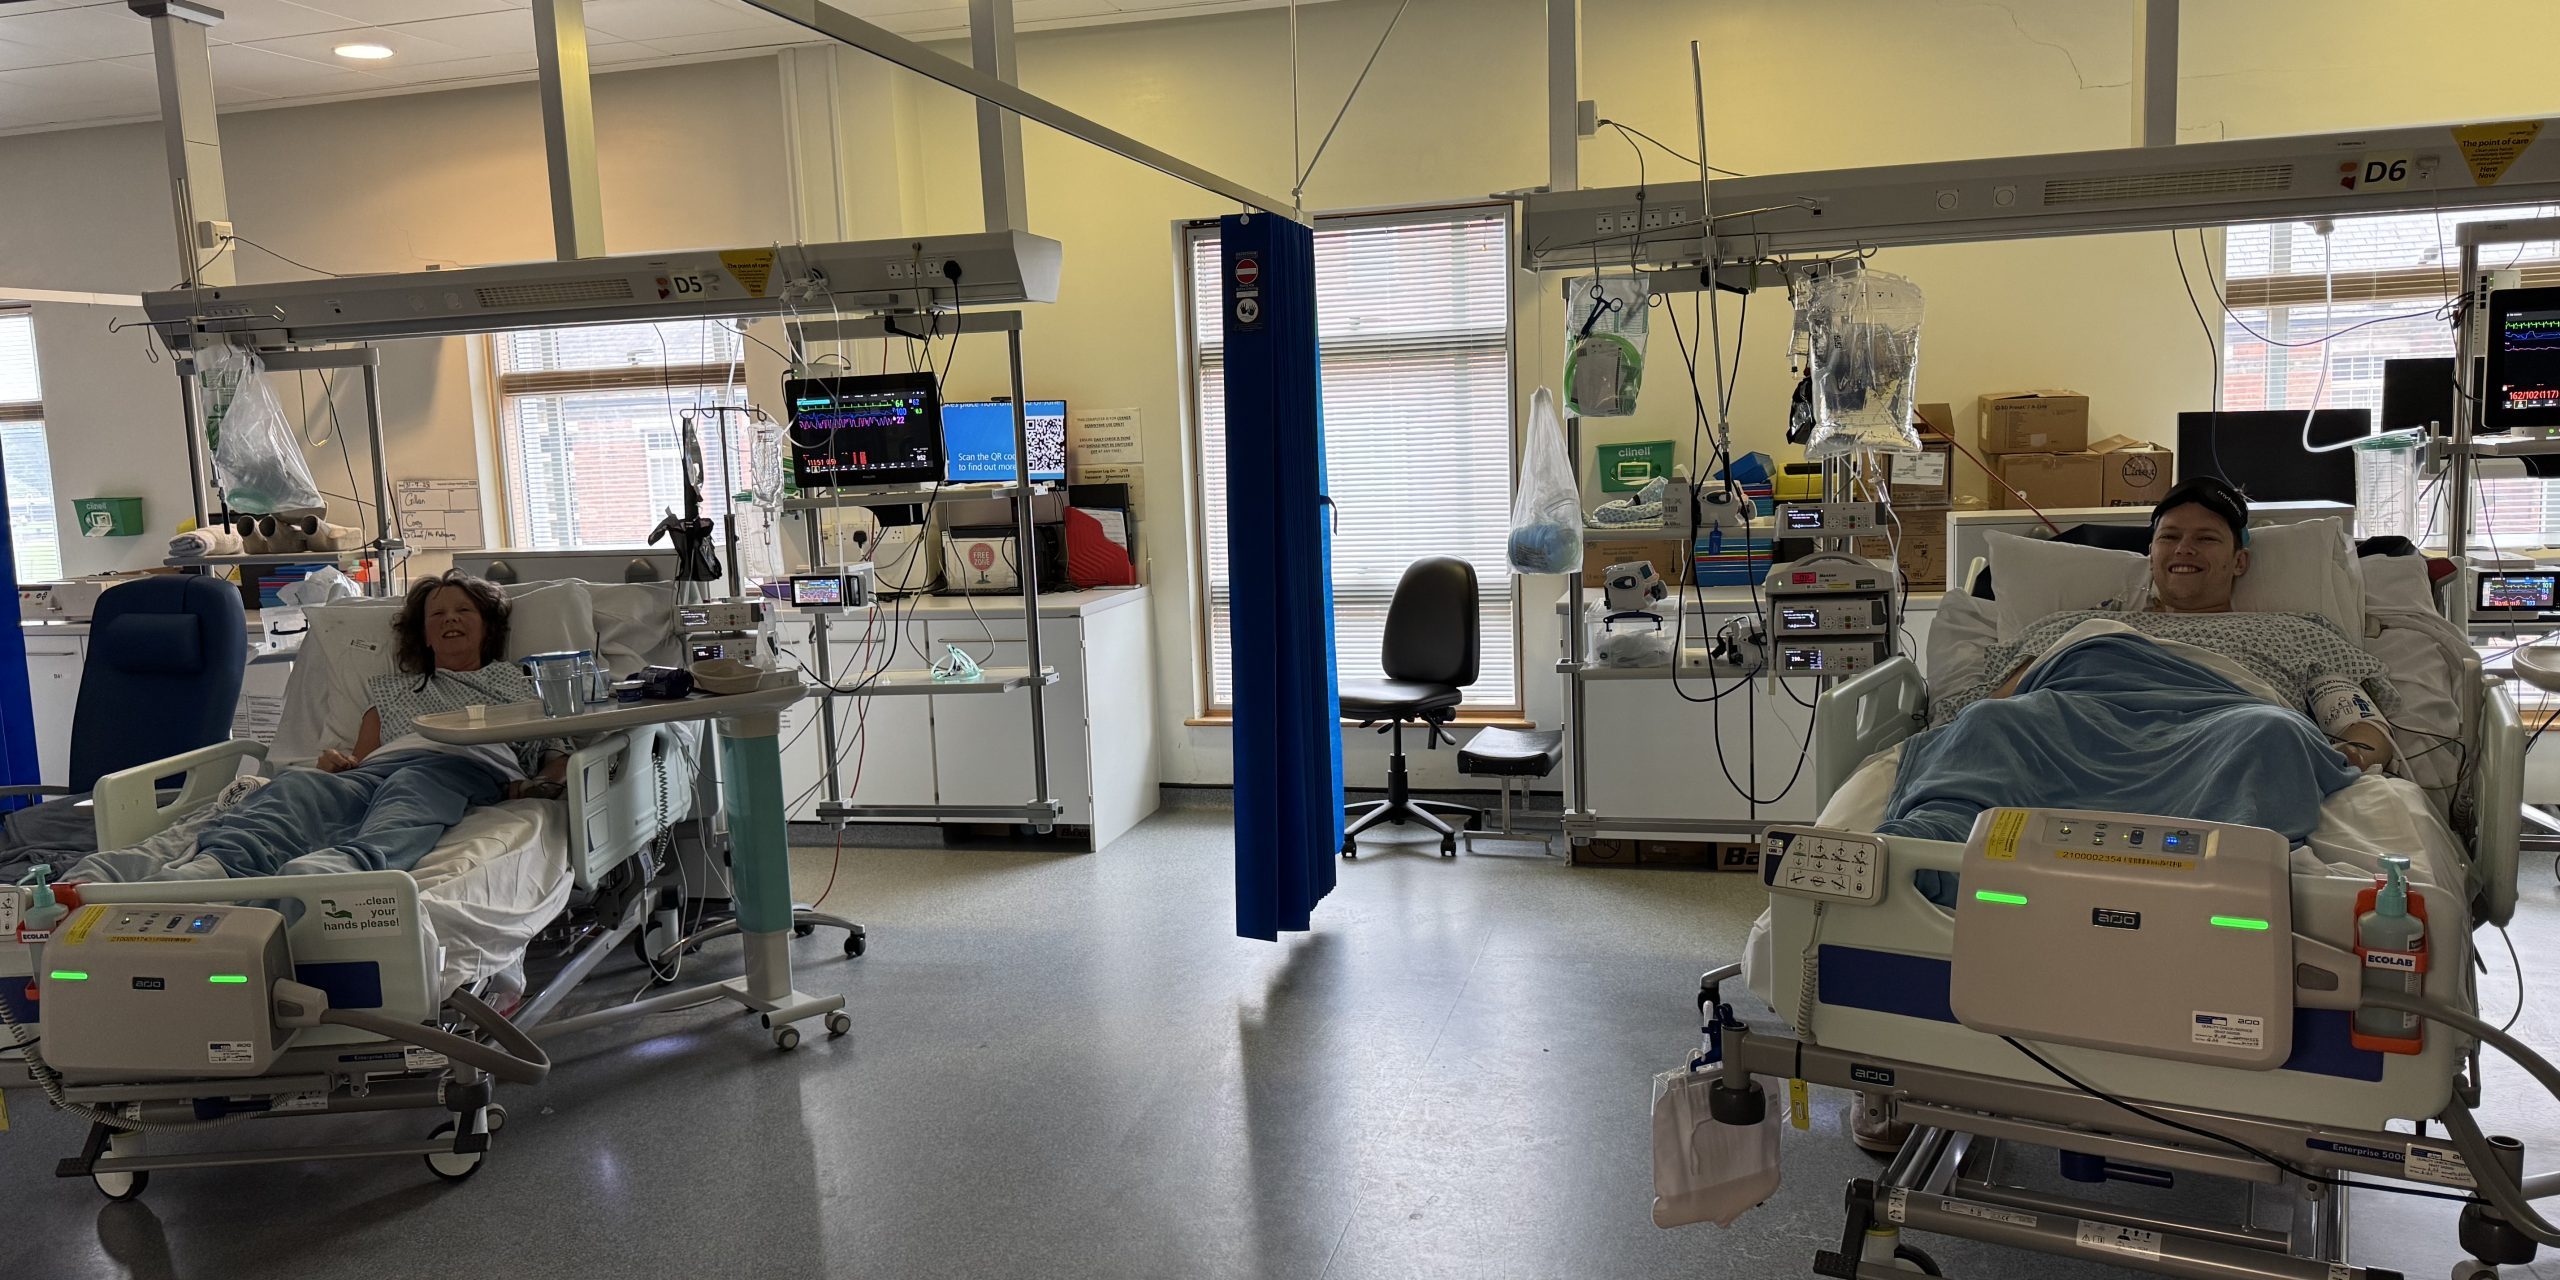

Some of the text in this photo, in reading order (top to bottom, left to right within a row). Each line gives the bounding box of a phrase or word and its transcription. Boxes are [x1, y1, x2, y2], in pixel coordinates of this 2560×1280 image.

[2478, 139, 2501, 149] point
[2364, 159, 2407, 183] D6
[674, 276, 702, 294] D5
[895, 399, 904, 407] 64
[896, 408, 907, 416] 100
[896, 416, 904, 424] 22
[1618, 446, 1650, 457] clinell
[958, 453, 976, 462] Scan
[977, 453, 989, 462] the
[990, 452, 1002, 462] QR
[968, 462, 982, 471] find
[973, 551, 990, 559] FREE
[355, 896, 396, 906] ...clean
[370, 908, 397, 919] your
[2097, 912, 2135, 926] arjo
[323, 917, 400, 932] hands please!
[2367, 954, 2413, 967] ECOLAB
[2332, 1144, 2380, 1158] Enterprise
